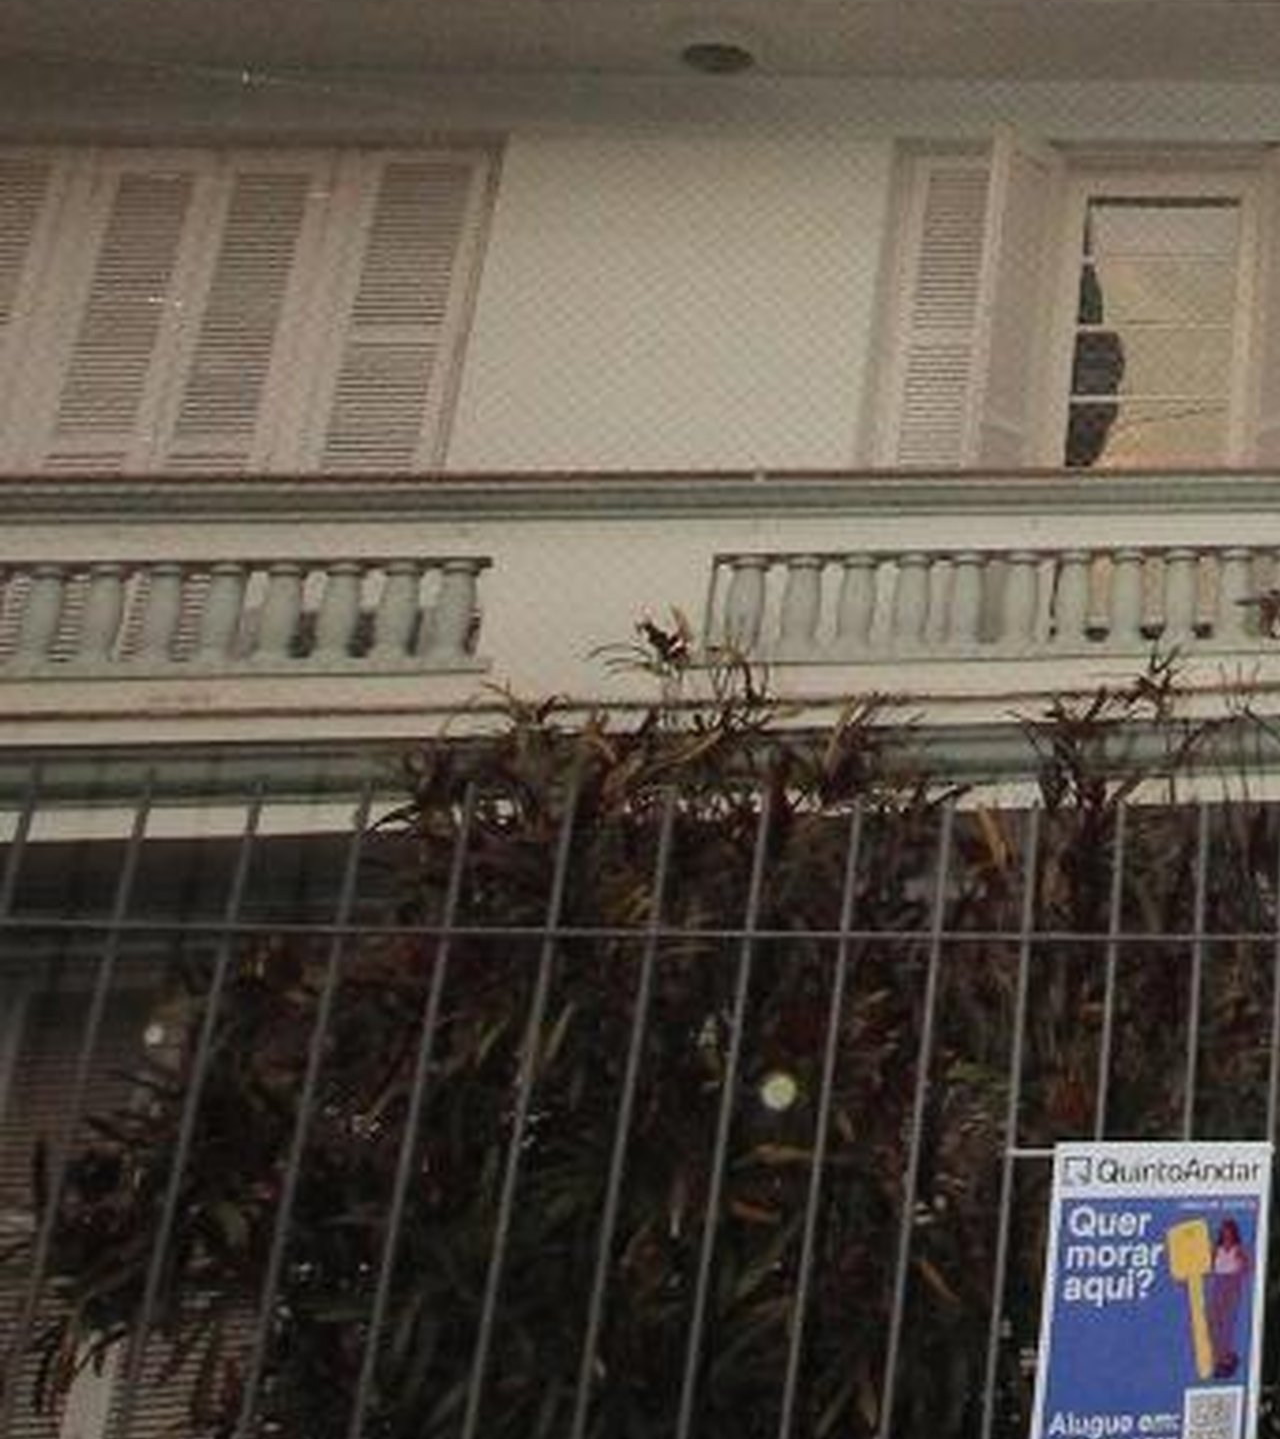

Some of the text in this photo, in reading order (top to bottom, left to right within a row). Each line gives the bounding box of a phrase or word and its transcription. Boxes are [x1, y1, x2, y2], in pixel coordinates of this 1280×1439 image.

[1097, 1158, 1260, 1184] QuintoAndar
[1070, 1205, 1151, 1238] Quer
[1066, 1242, 1163, 1269] morar
[1063, 1269, 1153, 1307] aqui?
[1049, 1411, 1132, 1439] Alugue
